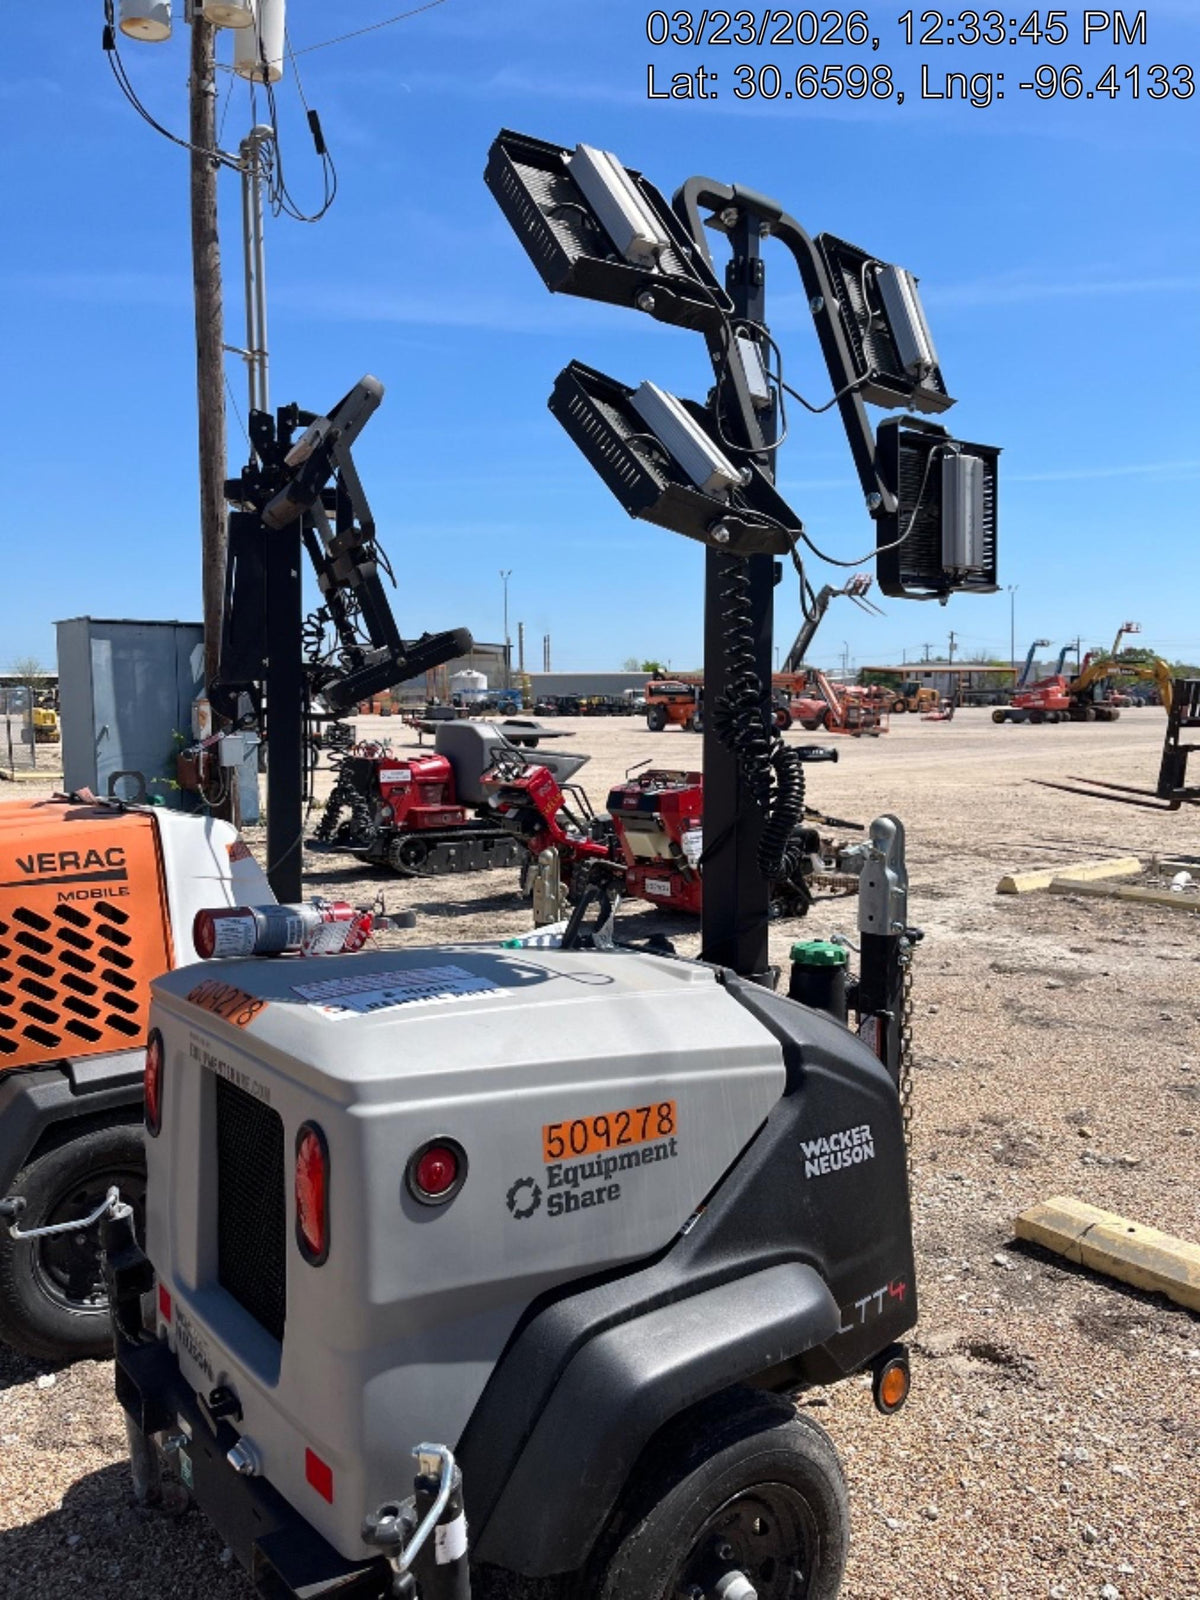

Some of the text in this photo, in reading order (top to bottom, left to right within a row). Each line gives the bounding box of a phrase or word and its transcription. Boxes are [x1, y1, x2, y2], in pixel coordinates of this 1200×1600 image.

[57, 886, 130, 902] MOBILE
[547, 1102, 674, 1159] 509278
[800, 1124, 874, 1159] WACKER
[546, 1137, 679, 1190] Equipment
[804, 1141, 876, 1179] NEUSON
[547, 1182, 621, 1218] Share
